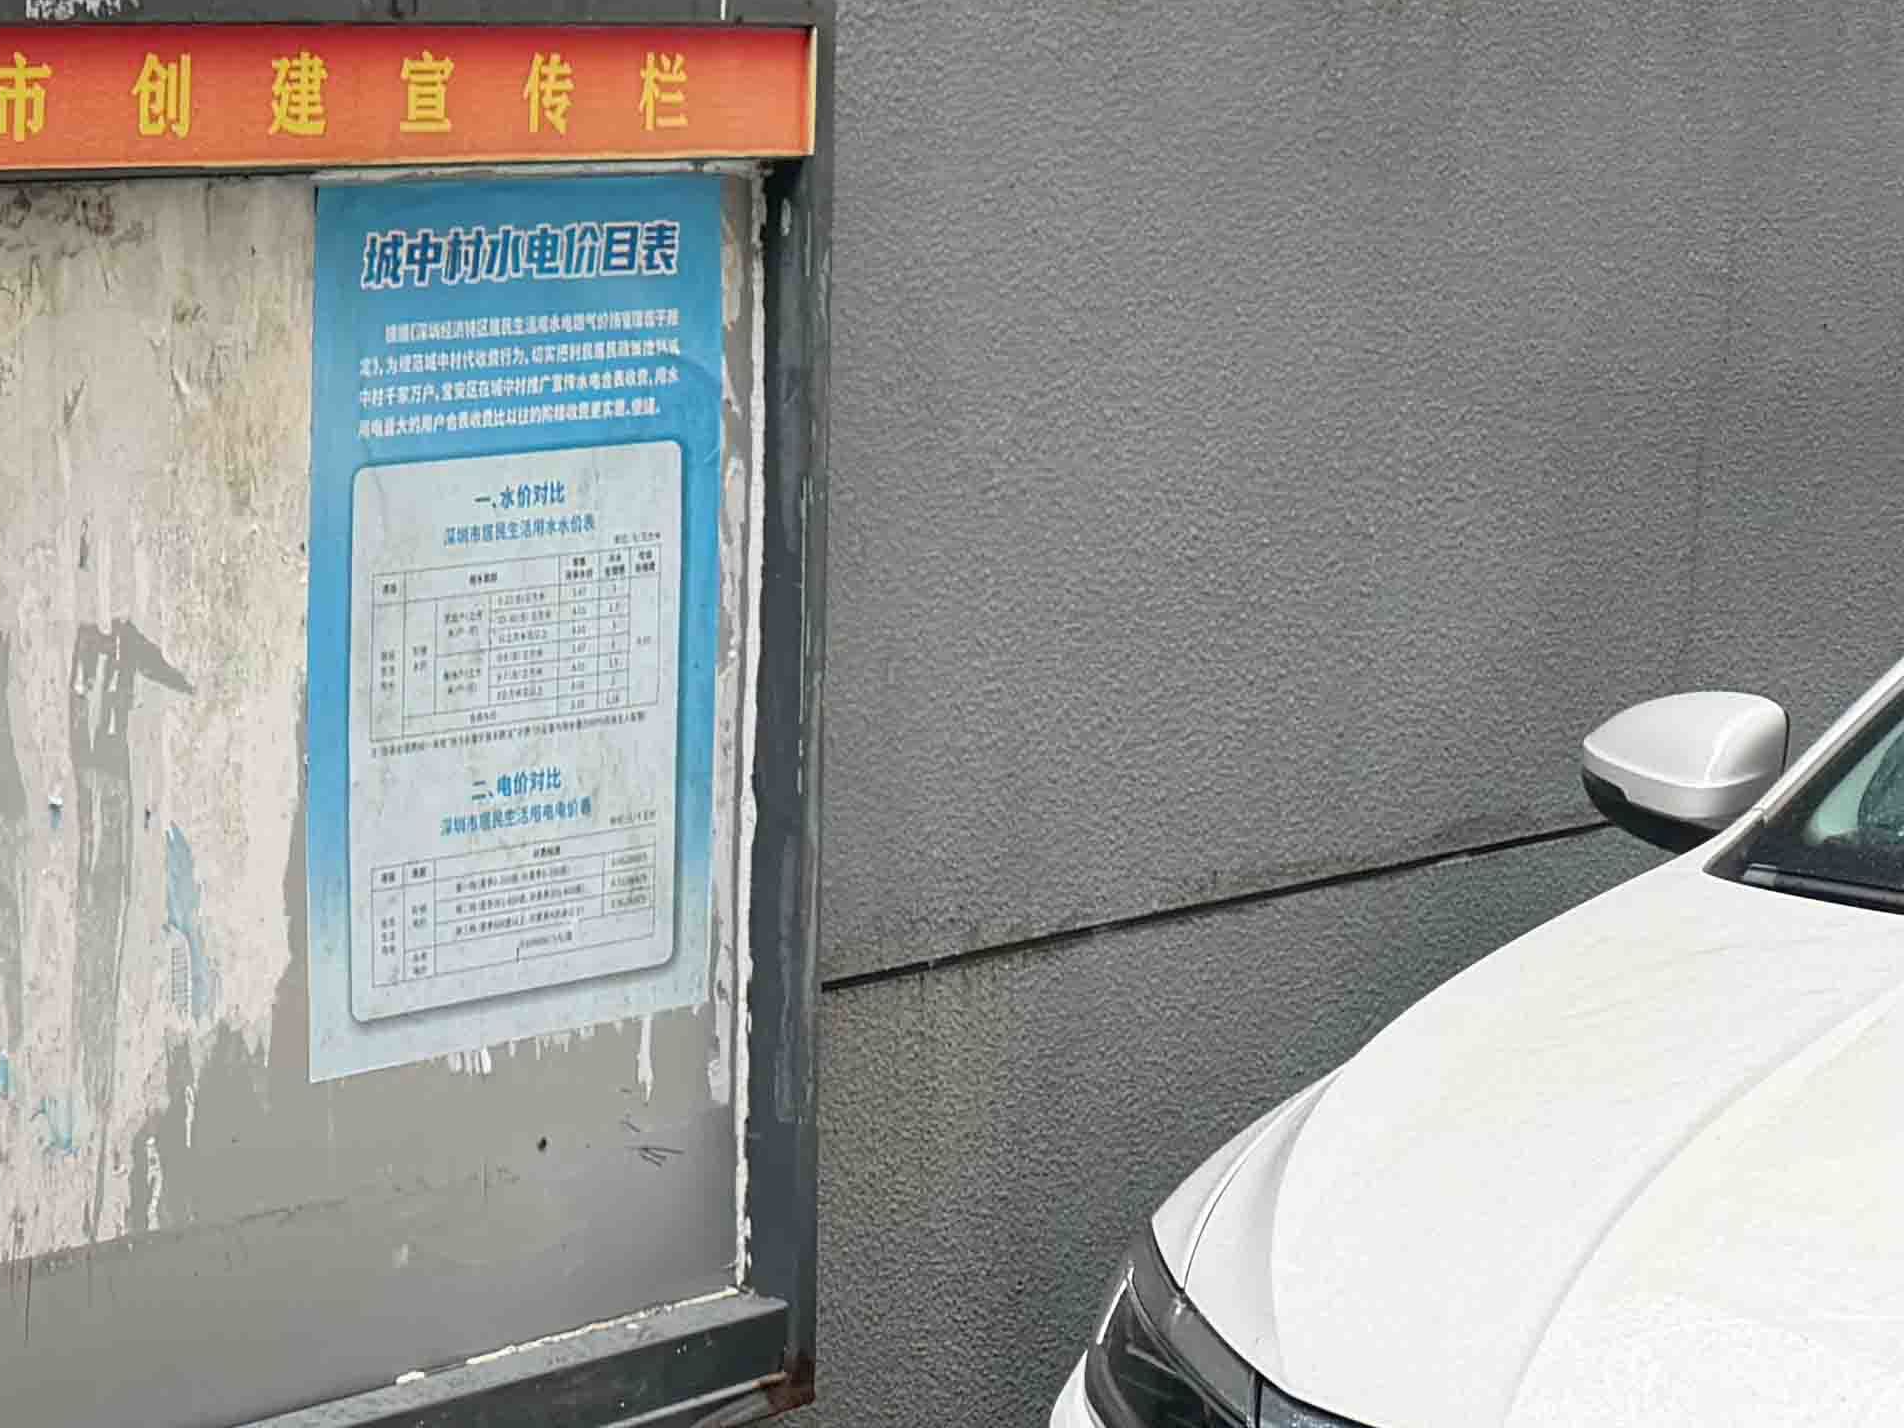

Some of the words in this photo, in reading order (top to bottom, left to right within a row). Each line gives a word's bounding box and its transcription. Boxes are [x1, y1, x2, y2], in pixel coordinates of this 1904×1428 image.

[362, 220, 680, 289] 城中村水电价目表
